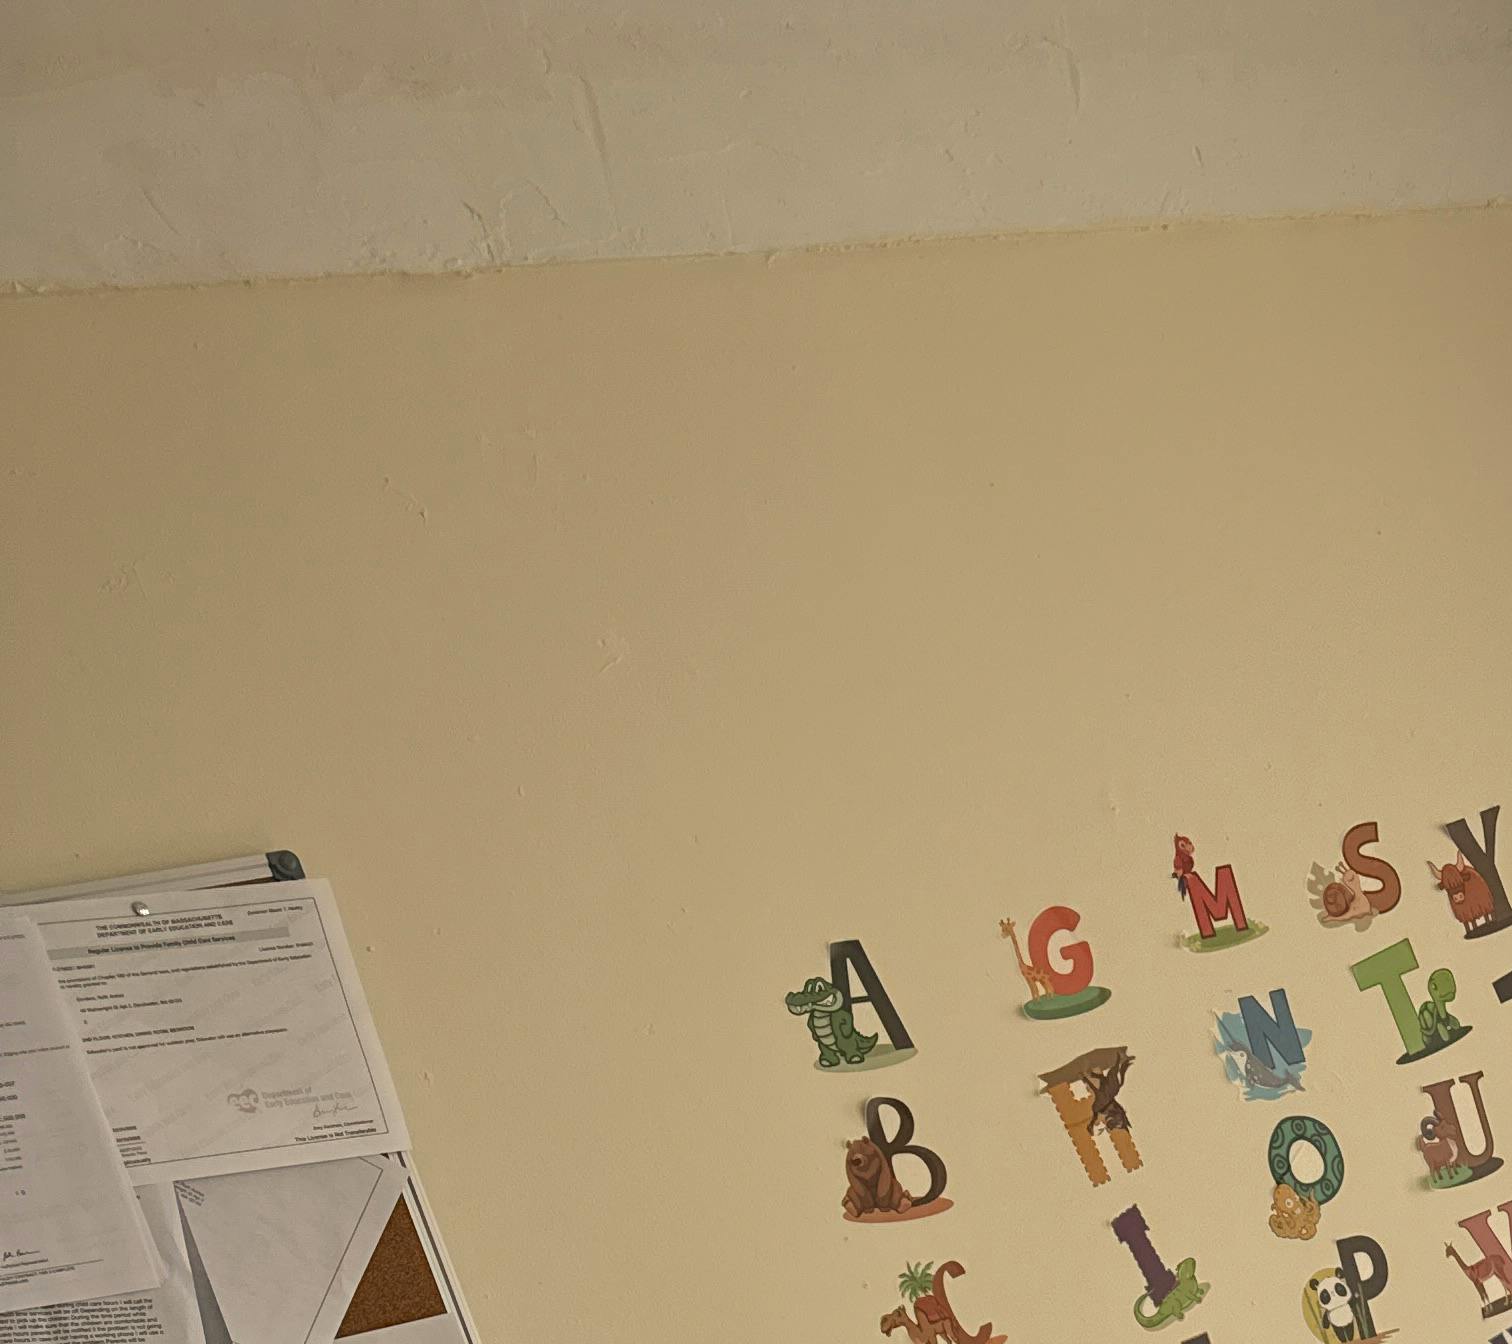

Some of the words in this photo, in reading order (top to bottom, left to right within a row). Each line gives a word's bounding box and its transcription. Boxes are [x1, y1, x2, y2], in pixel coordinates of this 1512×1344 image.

[1186, 864, 1251, 938] M
[1342, 821, 1401, 914] S
[827, 939, 914, 1051] A
[1028, 905, 1095, 996] G
[1351, 938, 1425, 1057] T
[1237, 988, 1308, 1068] N
[867, 1096, 948, 1206] B
[1267, 1115, 1345, 1206] O
[1421, 1070, 1493, 1177] U
[1110, 1204, 1175, 1307] I
[1335, 1235, 1389, 1342] P
